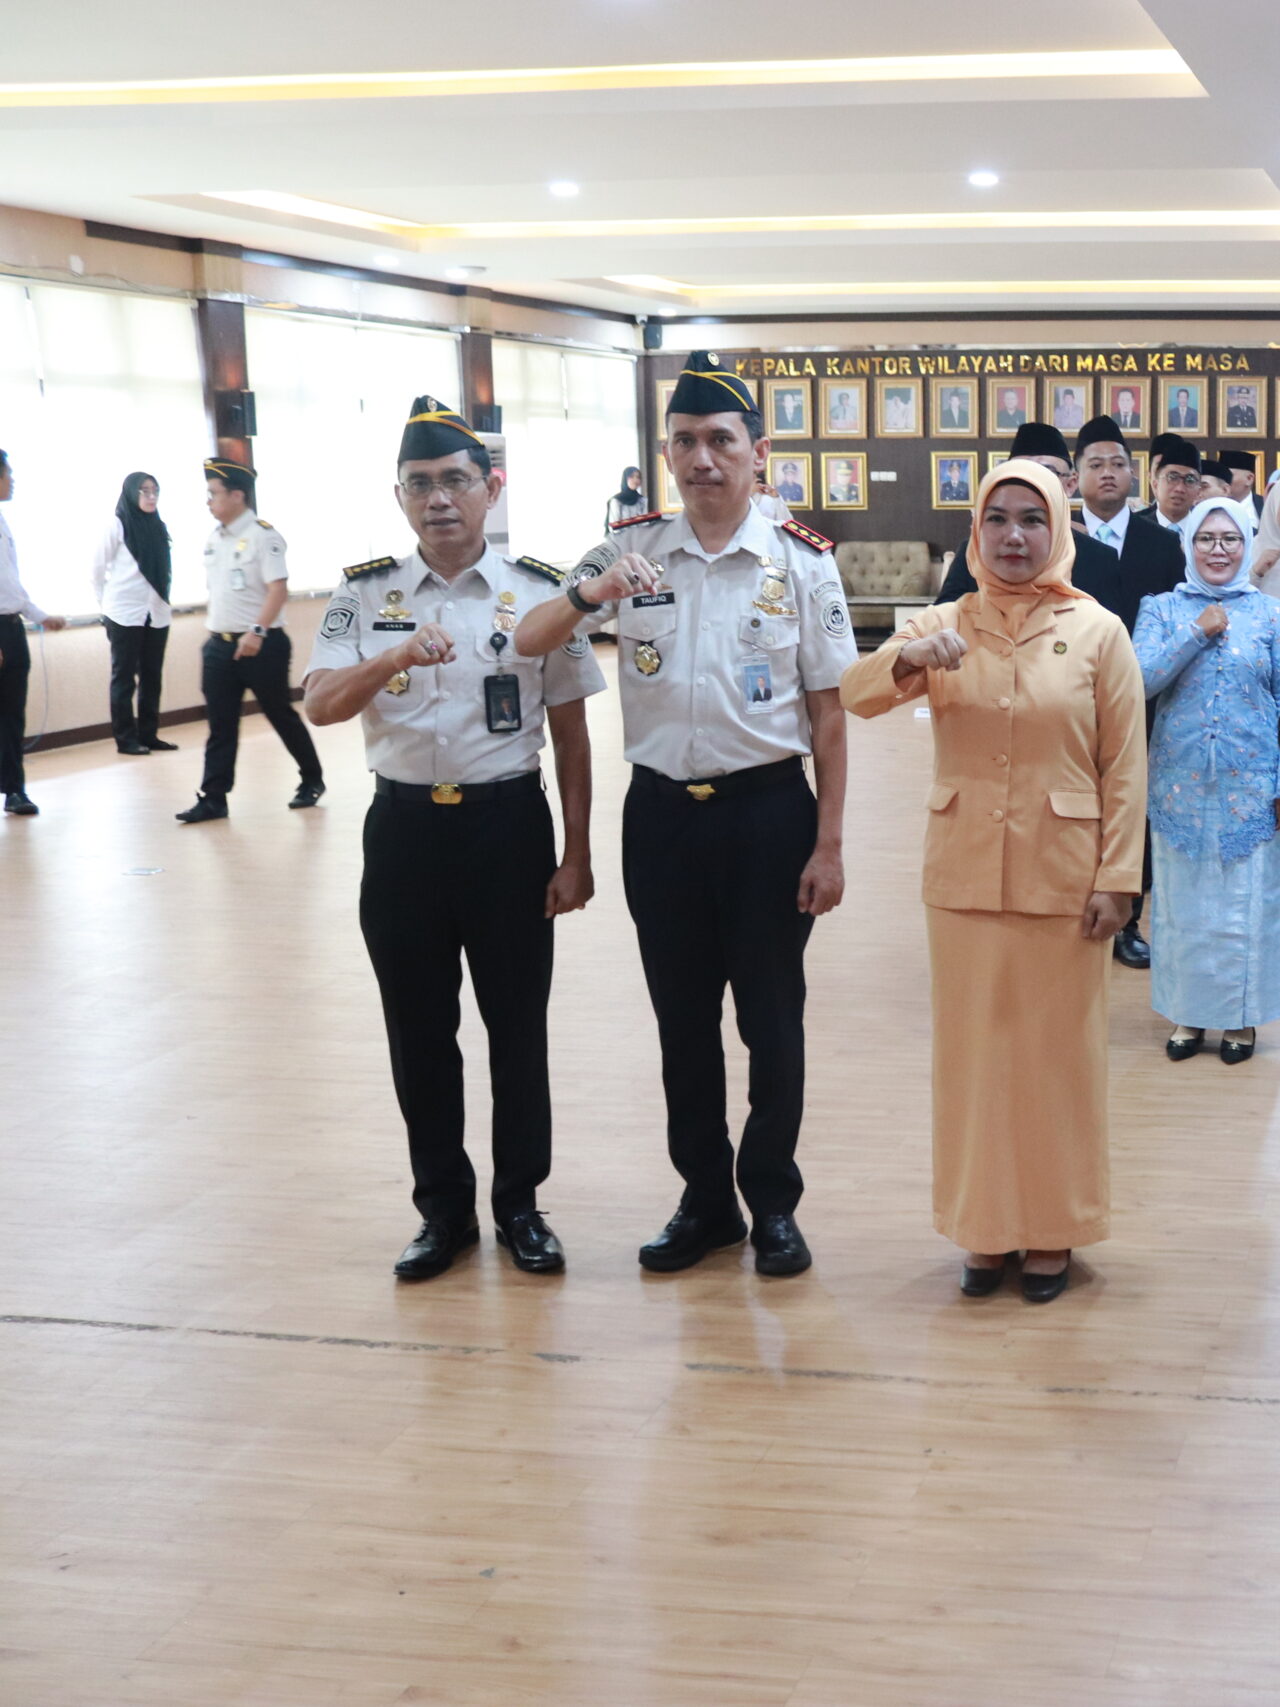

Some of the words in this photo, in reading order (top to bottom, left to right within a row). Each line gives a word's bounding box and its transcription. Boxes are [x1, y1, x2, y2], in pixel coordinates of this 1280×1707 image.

[735, 357, 817, 377] KEPALA
[826, 356, 913, 376] KANTOR
[917, 355, 1013, 375] WILAYAH
[1019, 354, 1069, 373] DARI
[1076, 353, 1138, 373] MASA
[1147, 353, 1176, 372] KE
[1185, 352, 1250, 371] MASA
